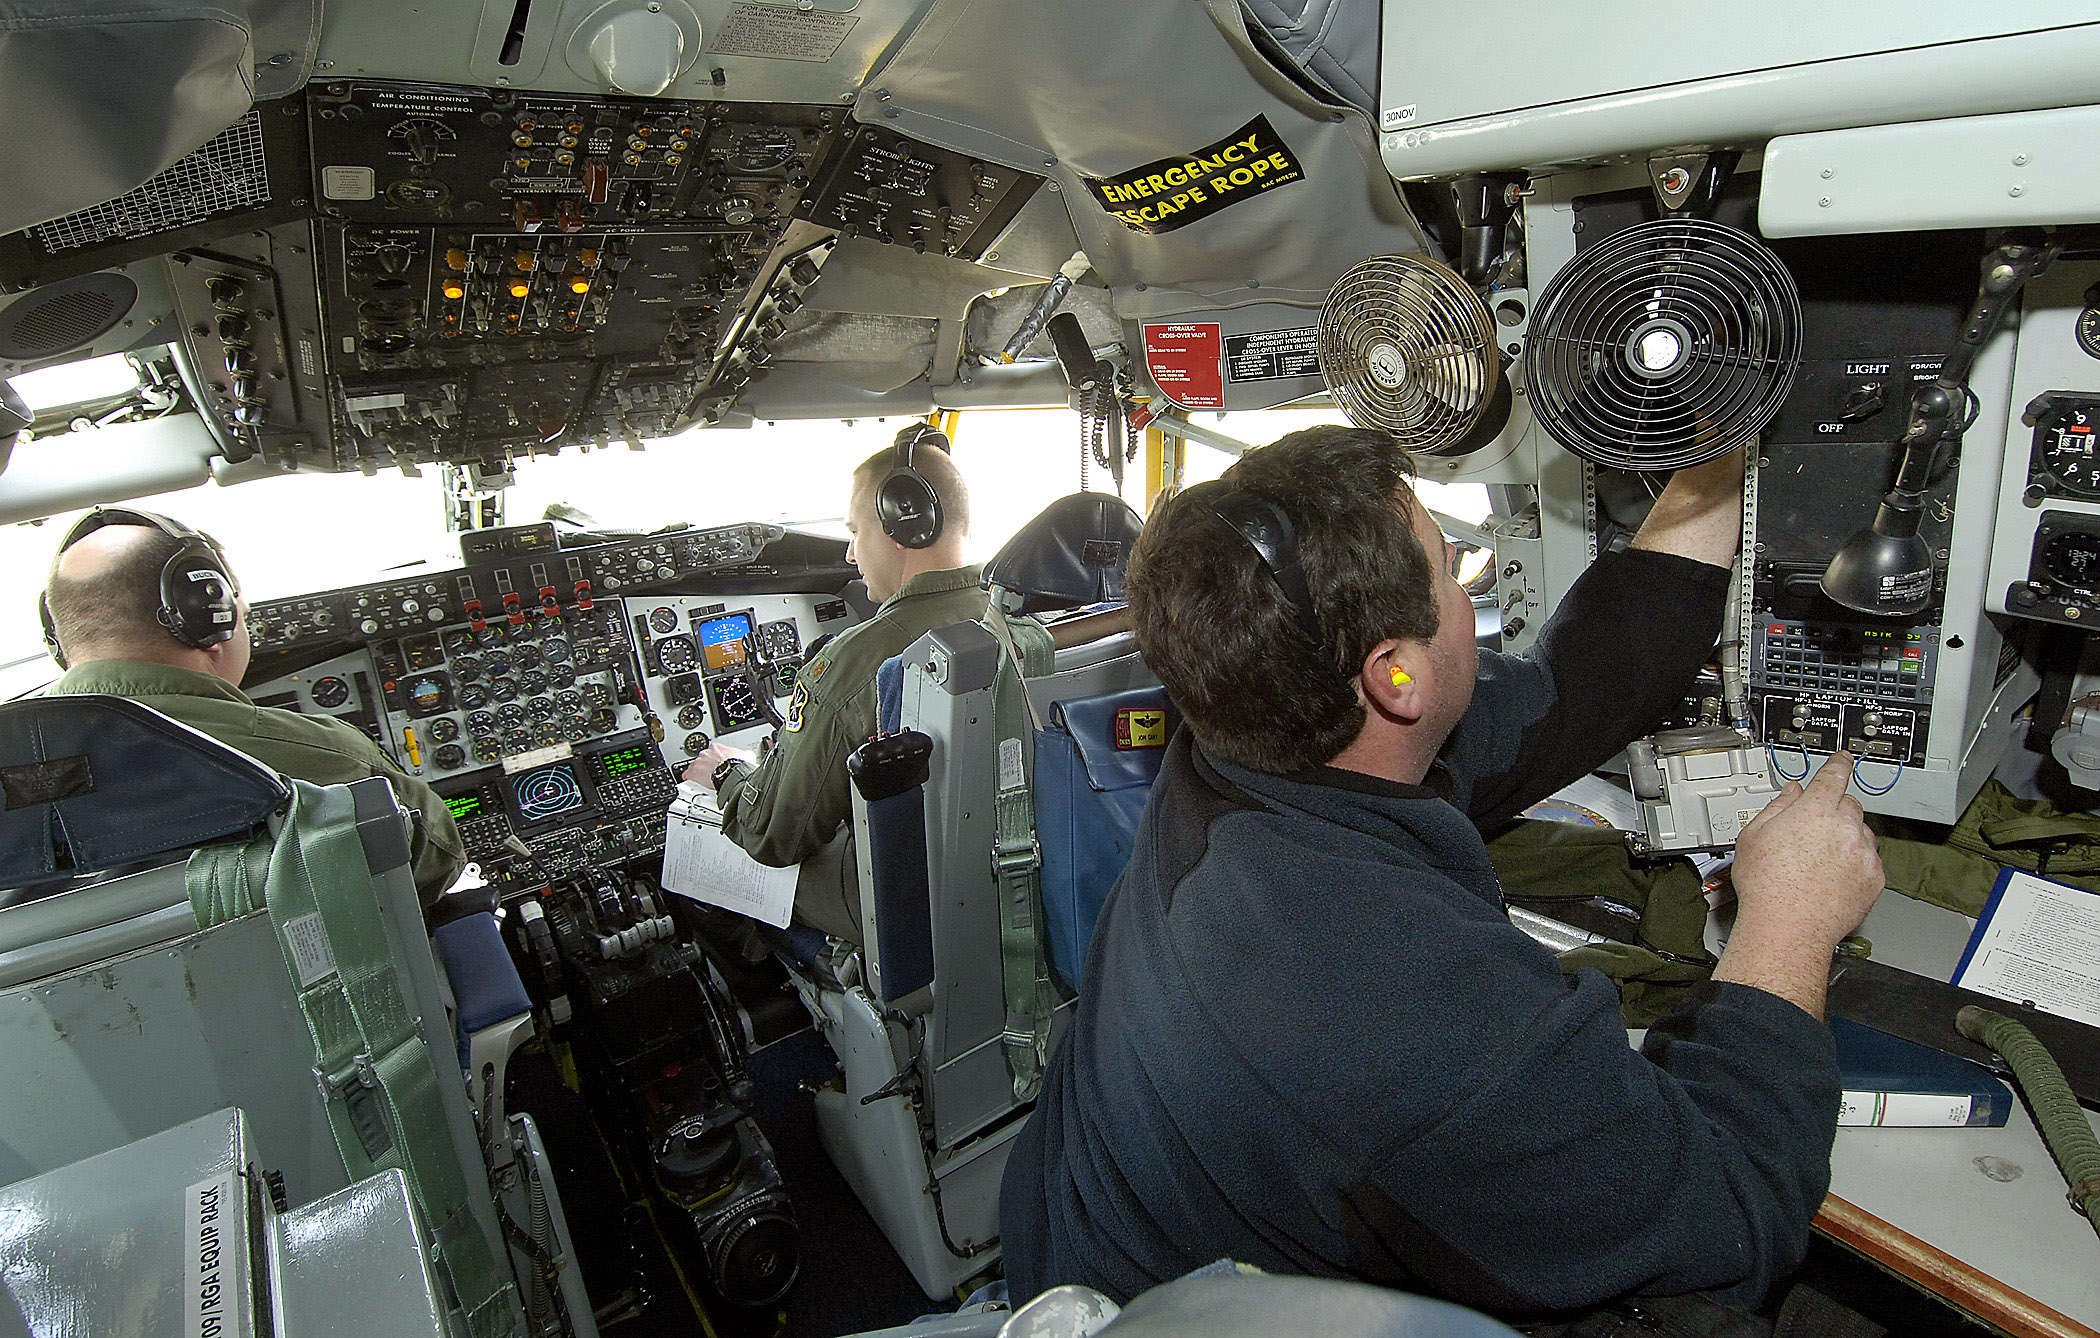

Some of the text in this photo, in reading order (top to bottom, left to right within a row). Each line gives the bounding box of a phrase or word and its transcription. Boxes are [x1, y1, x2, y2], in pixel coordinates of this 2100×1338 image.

[748, 10, 772, 18] CABIN
[773, 13, 797, 21] PRESS
[800, 17, 846, 27] CONTROLLER
[760, 6, 793, 15] INFLIGHT
[795, 11, 845, 21] MALFUNCTION
[399, 94, 470, 103] CONDITIONING
[371, 102, 474, 113] TEMPERATURE CONTROL
[1385, 107, 1415, 123] 30NOV
[1100, 133, 1261, 203] EMERGENCY
[1209, 151, 1290, 195] ROPE
[1246, 336, 1317, 348] INDEPENDENT HYDRAULIC
[1249, 333, 1289, 342] COMPONENTS
[1241, 347, 1277, 355] CROSS-OVER
[1277, 344, 1294, 352] LEVER
[1846, 364, 1890, 375] LIGHT
[2076, 414, 2087, 425] 9
[1818, 423, 1844, 433] OFF
[2068, 462, 2078, 473] 6
[2090, 470, 2100, 481] 5
[1815, 694, 1853, 702] LAPTOP
[1882, 724, 1909, 732] LAPTOP
[200, 1185, 224, 1338] 09/RGA EQUIP RACK
